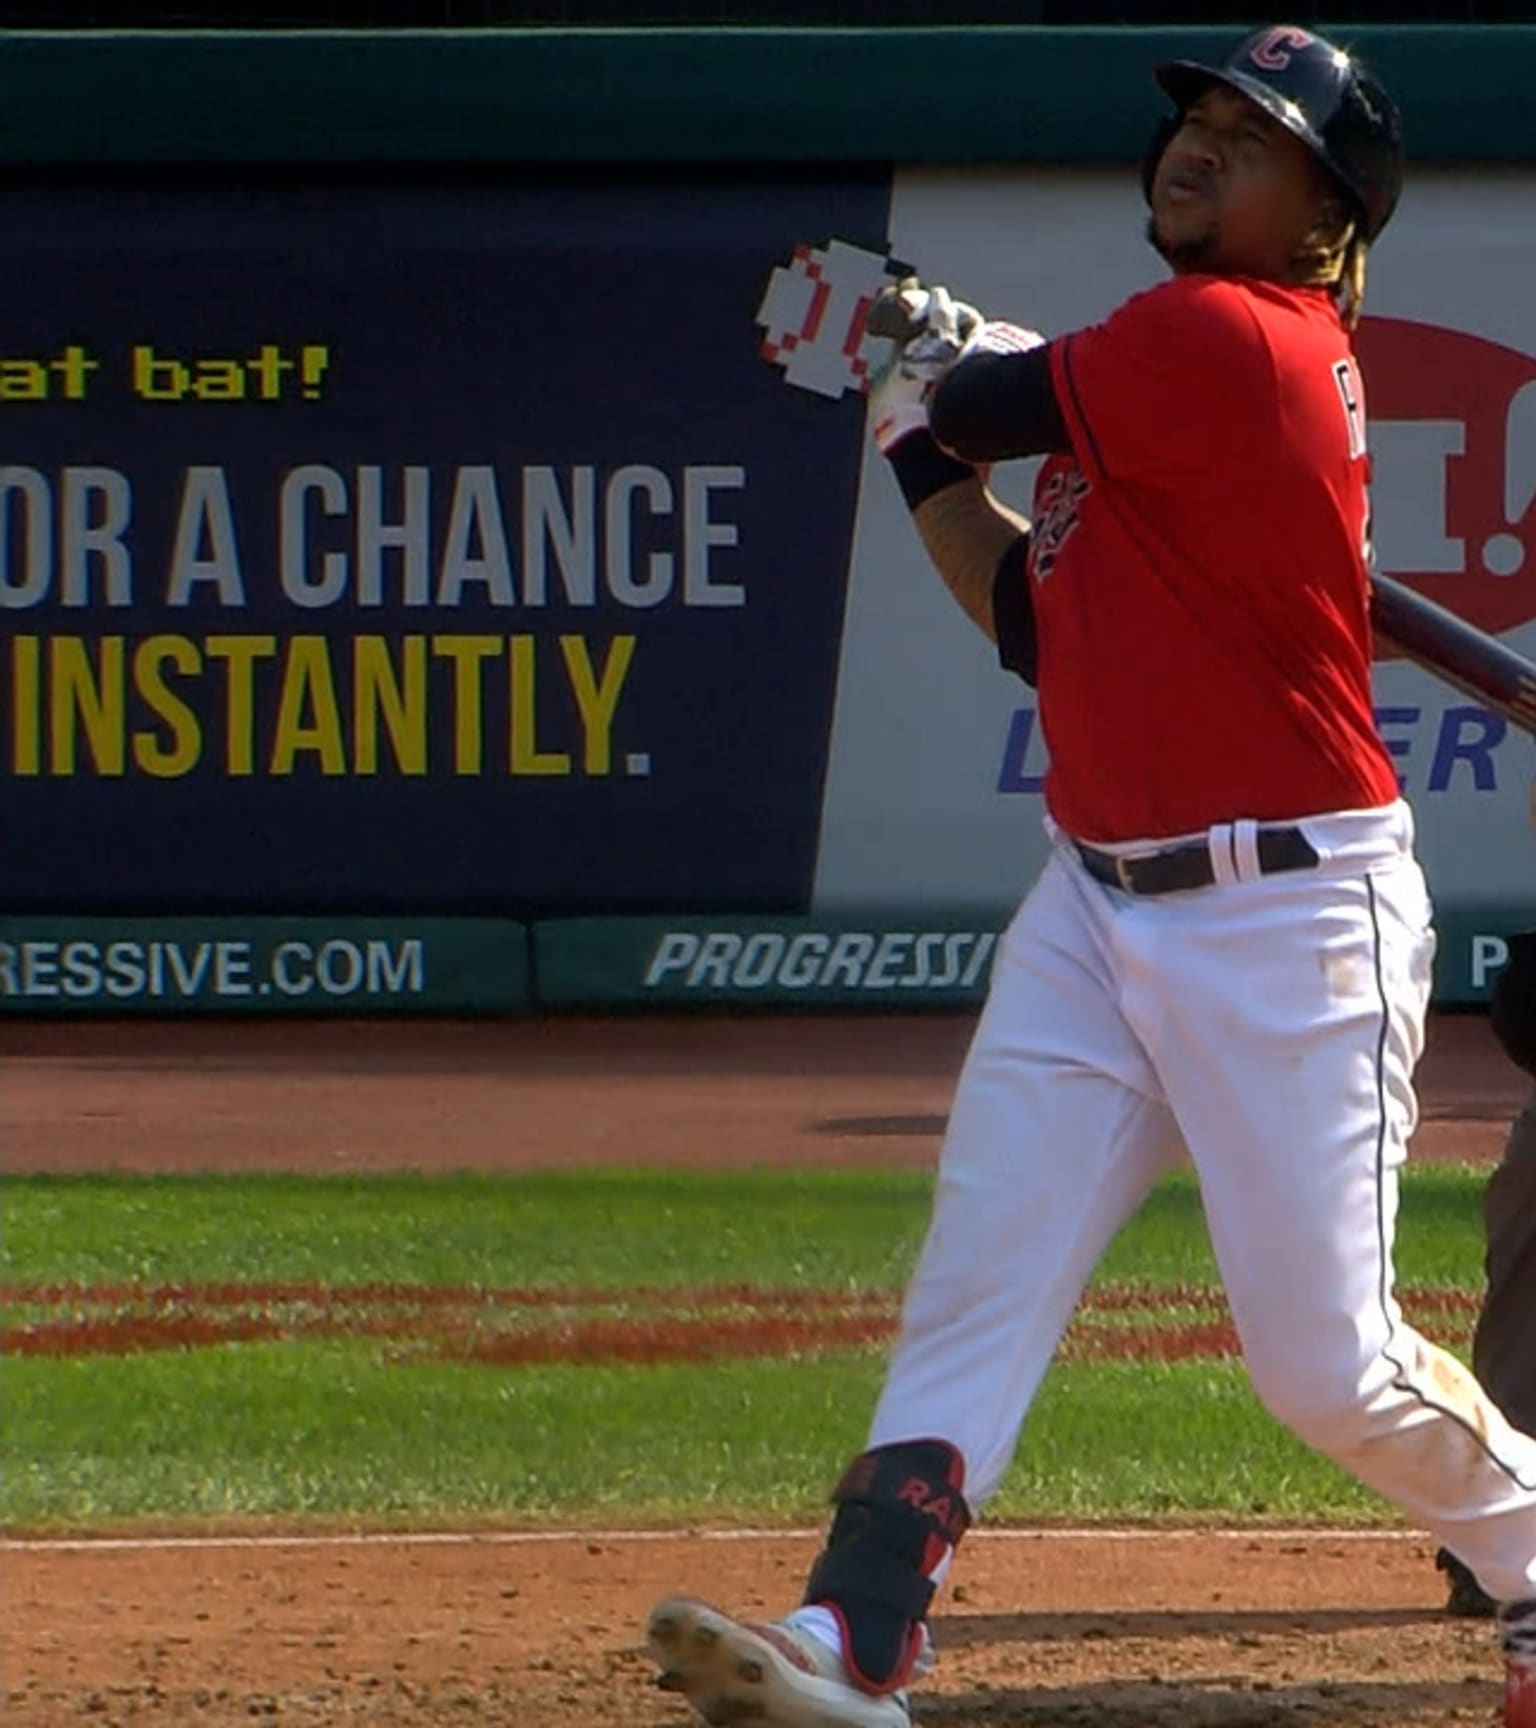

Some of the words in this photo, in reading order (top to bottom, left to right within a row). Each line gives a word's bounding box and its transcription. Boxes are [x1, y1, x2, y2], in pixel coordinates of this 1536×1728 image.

[1250, 26, 1314, 70] C
[0, 347, 98, 399] at
[132, 346, 330, 399] bat!
[0, 465, 133, 608] OR
[166, 465, 247, 606] A
[280, 464, 746, 608] CHANCE
[13, 634, 651, 778] INSTANTLY.
[643, 932, 997, 988] PROGRESSI
